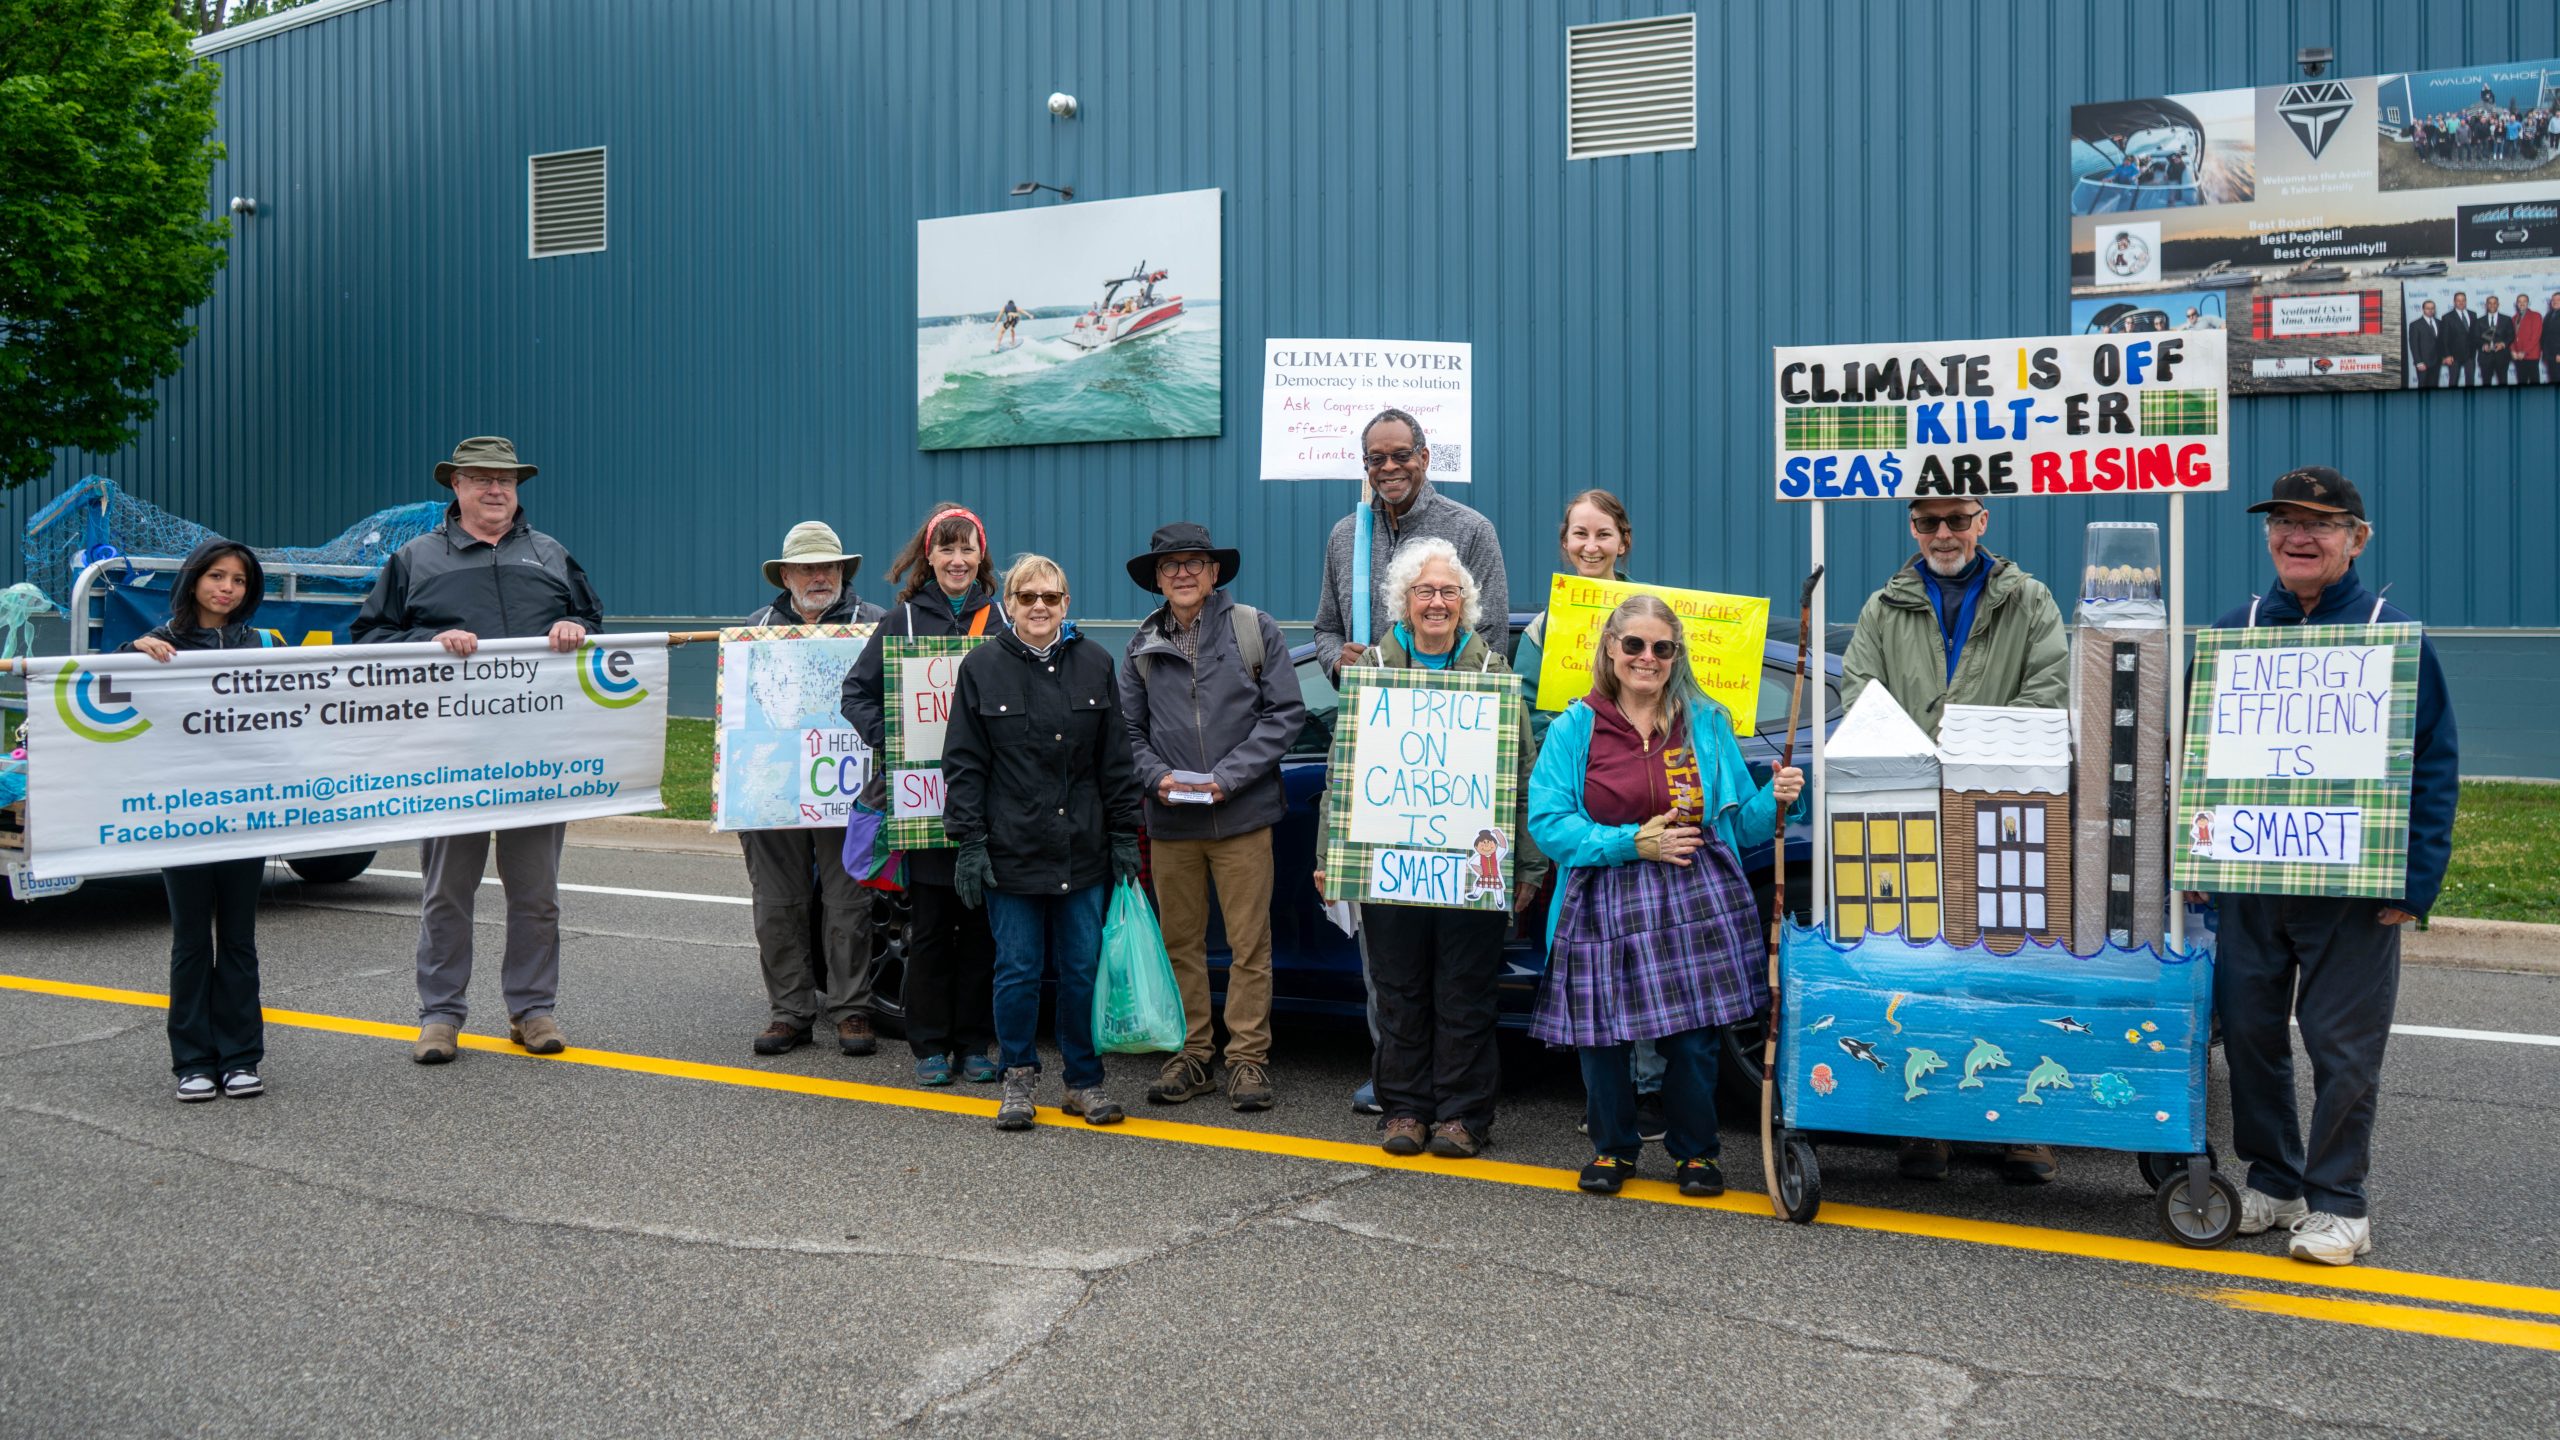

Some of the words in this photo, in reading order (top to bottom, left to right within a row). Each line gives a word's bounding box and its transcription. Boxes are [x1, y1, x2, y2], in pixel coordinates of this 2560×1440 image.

[2429, 75, 2482, 87] AVALON
[2491, 71, 2539, 82] TAHOE
[2262, 174, 2306, 185] Welcome
[2308, 174, 2319, 182] to
[2320, 171, 2337, 180] the
[2339, 168, 2373, 179] Avalon
[2291, 183, 2320, 194] Tahoe
[2321, 180, 2354, 193] Family
[2249, 219, 2275, 231] Best
[2278, 216, 2324, 229] Boats!!!
[2259, 233, 2287, 245] Best
[2288, 229, 2343, 244] People!!!
[2273, 247, 2300, 259] Best
[2302, 241, 2387, 257] Community!!!
[2280, 305, 2320, 316] Scotland
[2309, 314, 2352, 325] Michigan
[1273, 351, 1377, 368] CLIMATE
[1384, 352, 1463, 371] VOTER
[1780, 354, 1995, 404] CLIMATE
[2016, 347, 2062, 391] IS
[2093, 338, 2184, 387] OFF
[1275, 373, 1357, 390] Democracy
[1362, 374, 1373, 387] is
[1377, 375, 1399, 388] the
[1402, 376, 1461, 390] solution
[1283, 396, 1311, 411] Ask
[1323, 398, 1375, 416] Congress
[1402, 404, 1444, 416] support
[1298, 446, 1356, 460] climate
[1779, 450, 1904, 499] SEA$
[1914, 451, 2019, 496] ARE
[2030, 443, 2212, 494] RISING
[1571, 588, 1625, 606] EFFEC
[1674, 599, 1742, 620] POLICIES
[347, 662, 455, 688] Climate
[463, 656, 539, 684] Lobby
[1696, 671, 1750, 690] shback
[2232, 649, 2375, 691] ENERGY
[320, 698, 429, 725] Climate
[438, 690, 563, 718] Education
[1370, 687, 1391, 728] A
[1411, 689, 1496, 731] PRICE
[2218, 690, 2388, 735] EFFICIENCY
[1400, 731, 1446, 767] ON
[2266, 745, 2315, 777] IS
[122, 757, 604, 815] mt.pleasant.mi@citizensclimatelobby.org
[1365, 766, 1489, 810] CARBON
[99, 815, 236, 845] Facebook:
[246, 779, 620, 831] Mt.PleasantCitizensClimateLobby
[821, 801, 853, 817] THER
[1396, 814, 1447, 847] IS
[2230, 810, 2359, 860] SMART
[1379, 851, 1466, 905] SMART
